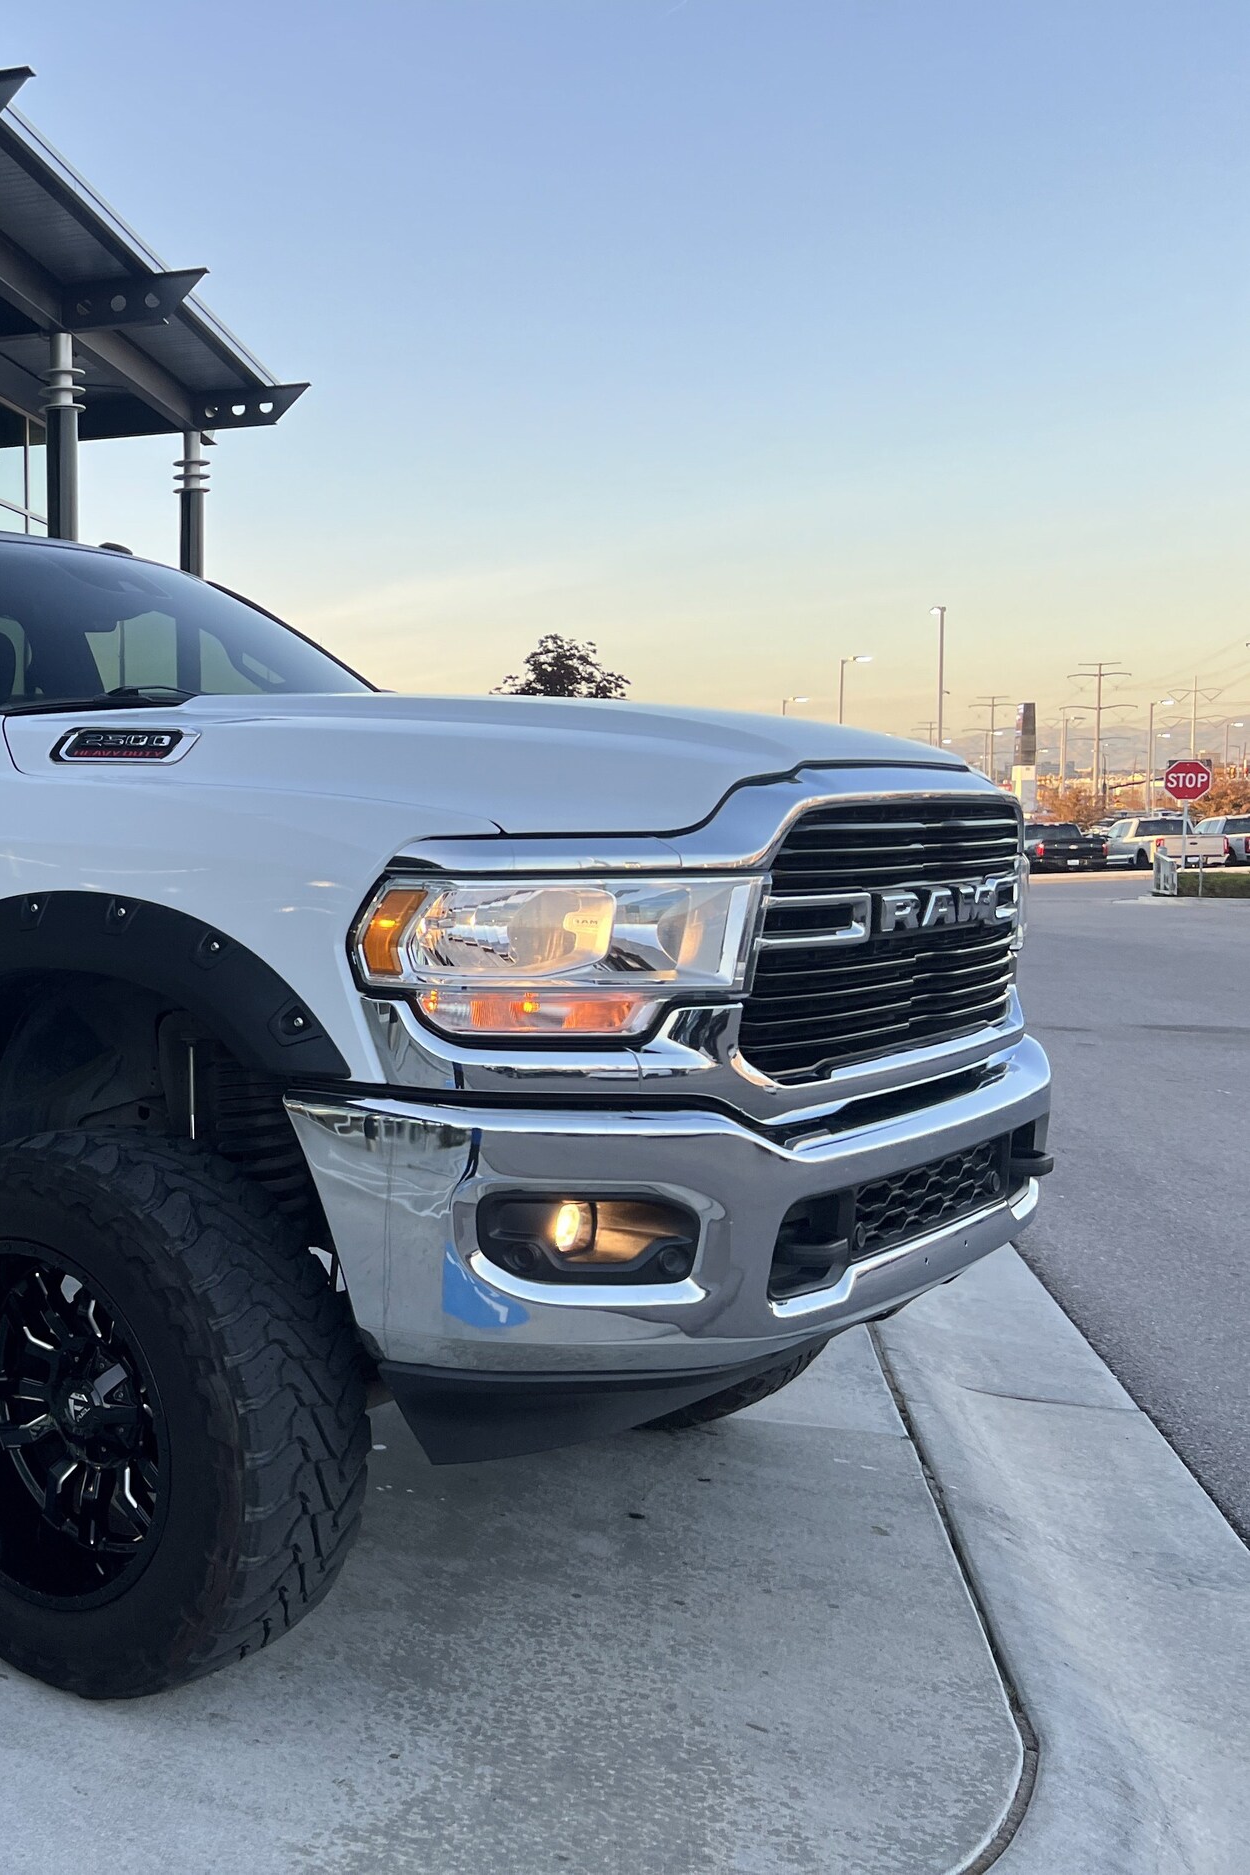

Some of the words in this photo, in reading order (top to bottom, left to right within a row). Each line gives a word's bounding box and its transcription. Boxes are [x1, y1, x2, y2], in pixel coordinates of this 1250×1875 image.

[80, 733, 172, 747] 2500
[1166, 772, 1209, 789] STOP
[880, 884, 994, 932] RAM
[76, 1408, 90, 1422] FUEL
